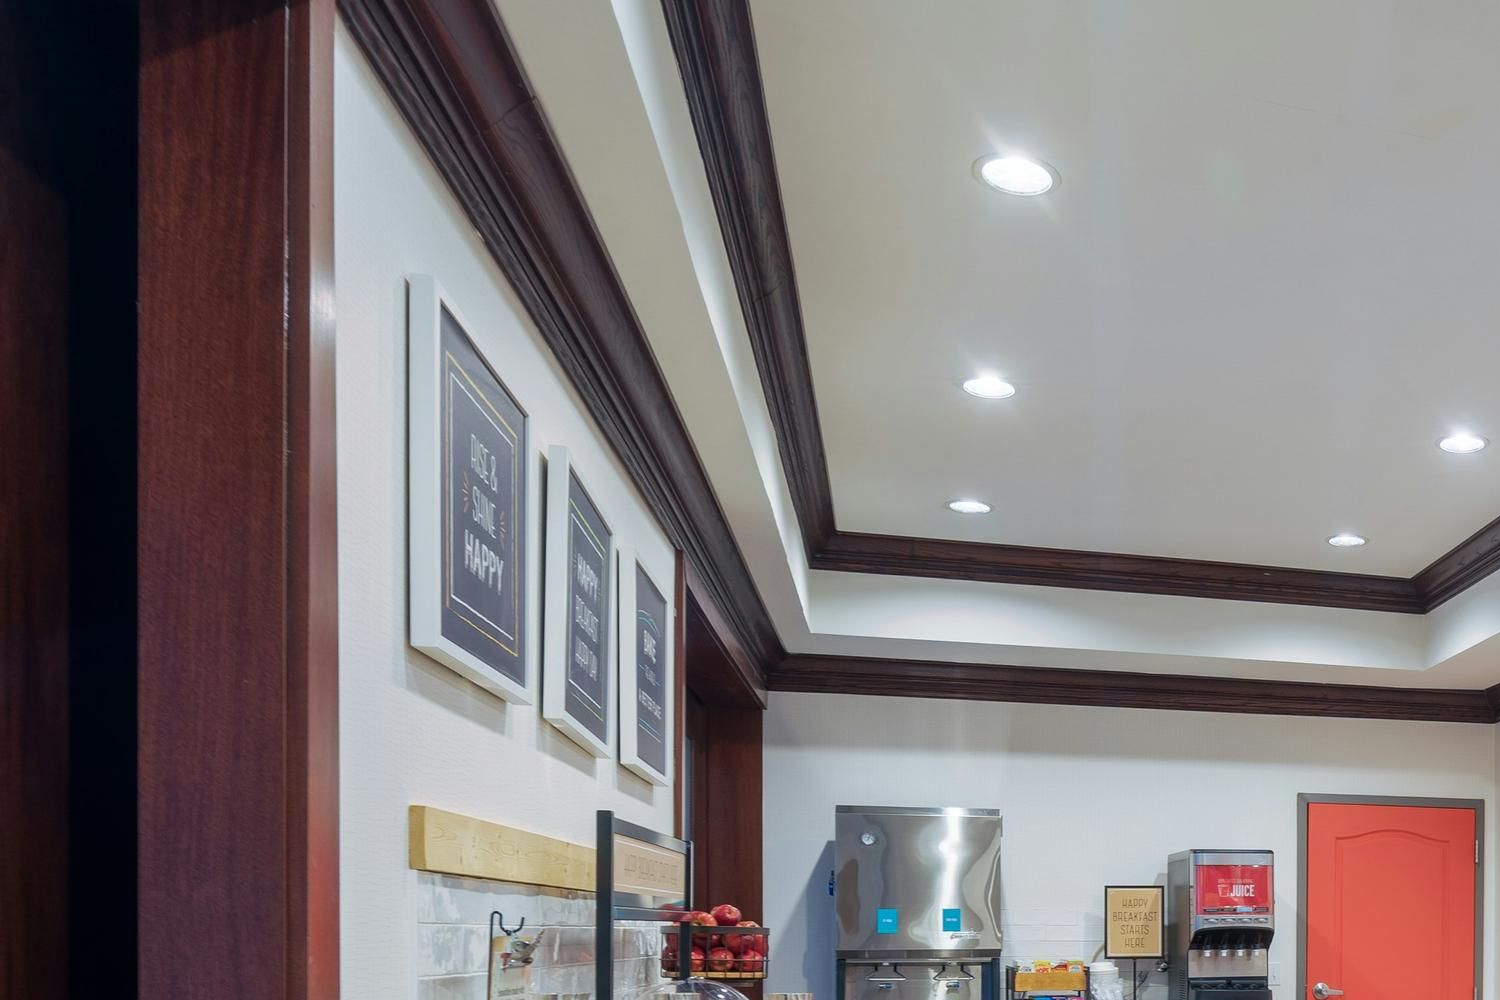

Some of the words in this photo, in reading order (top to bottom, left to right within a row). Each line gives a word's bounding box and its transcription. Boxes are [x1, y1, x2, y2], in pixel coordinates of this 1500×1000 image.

[471, 434, 489, 485] RISE
[490, 456, 498, 494] &
[472, 486, 496, 539] SHINE
[465, 529, 504, 595] HAPPY
[1230, 884, 1255, 897] JUICE
[1121, 898, 1148, 908] HAPPY
[1112, 911, 1158, 922] BREAKFAST
[1120, 924, 1150, 935] STARTS
[1124, 937, 1145, 948] HERE
